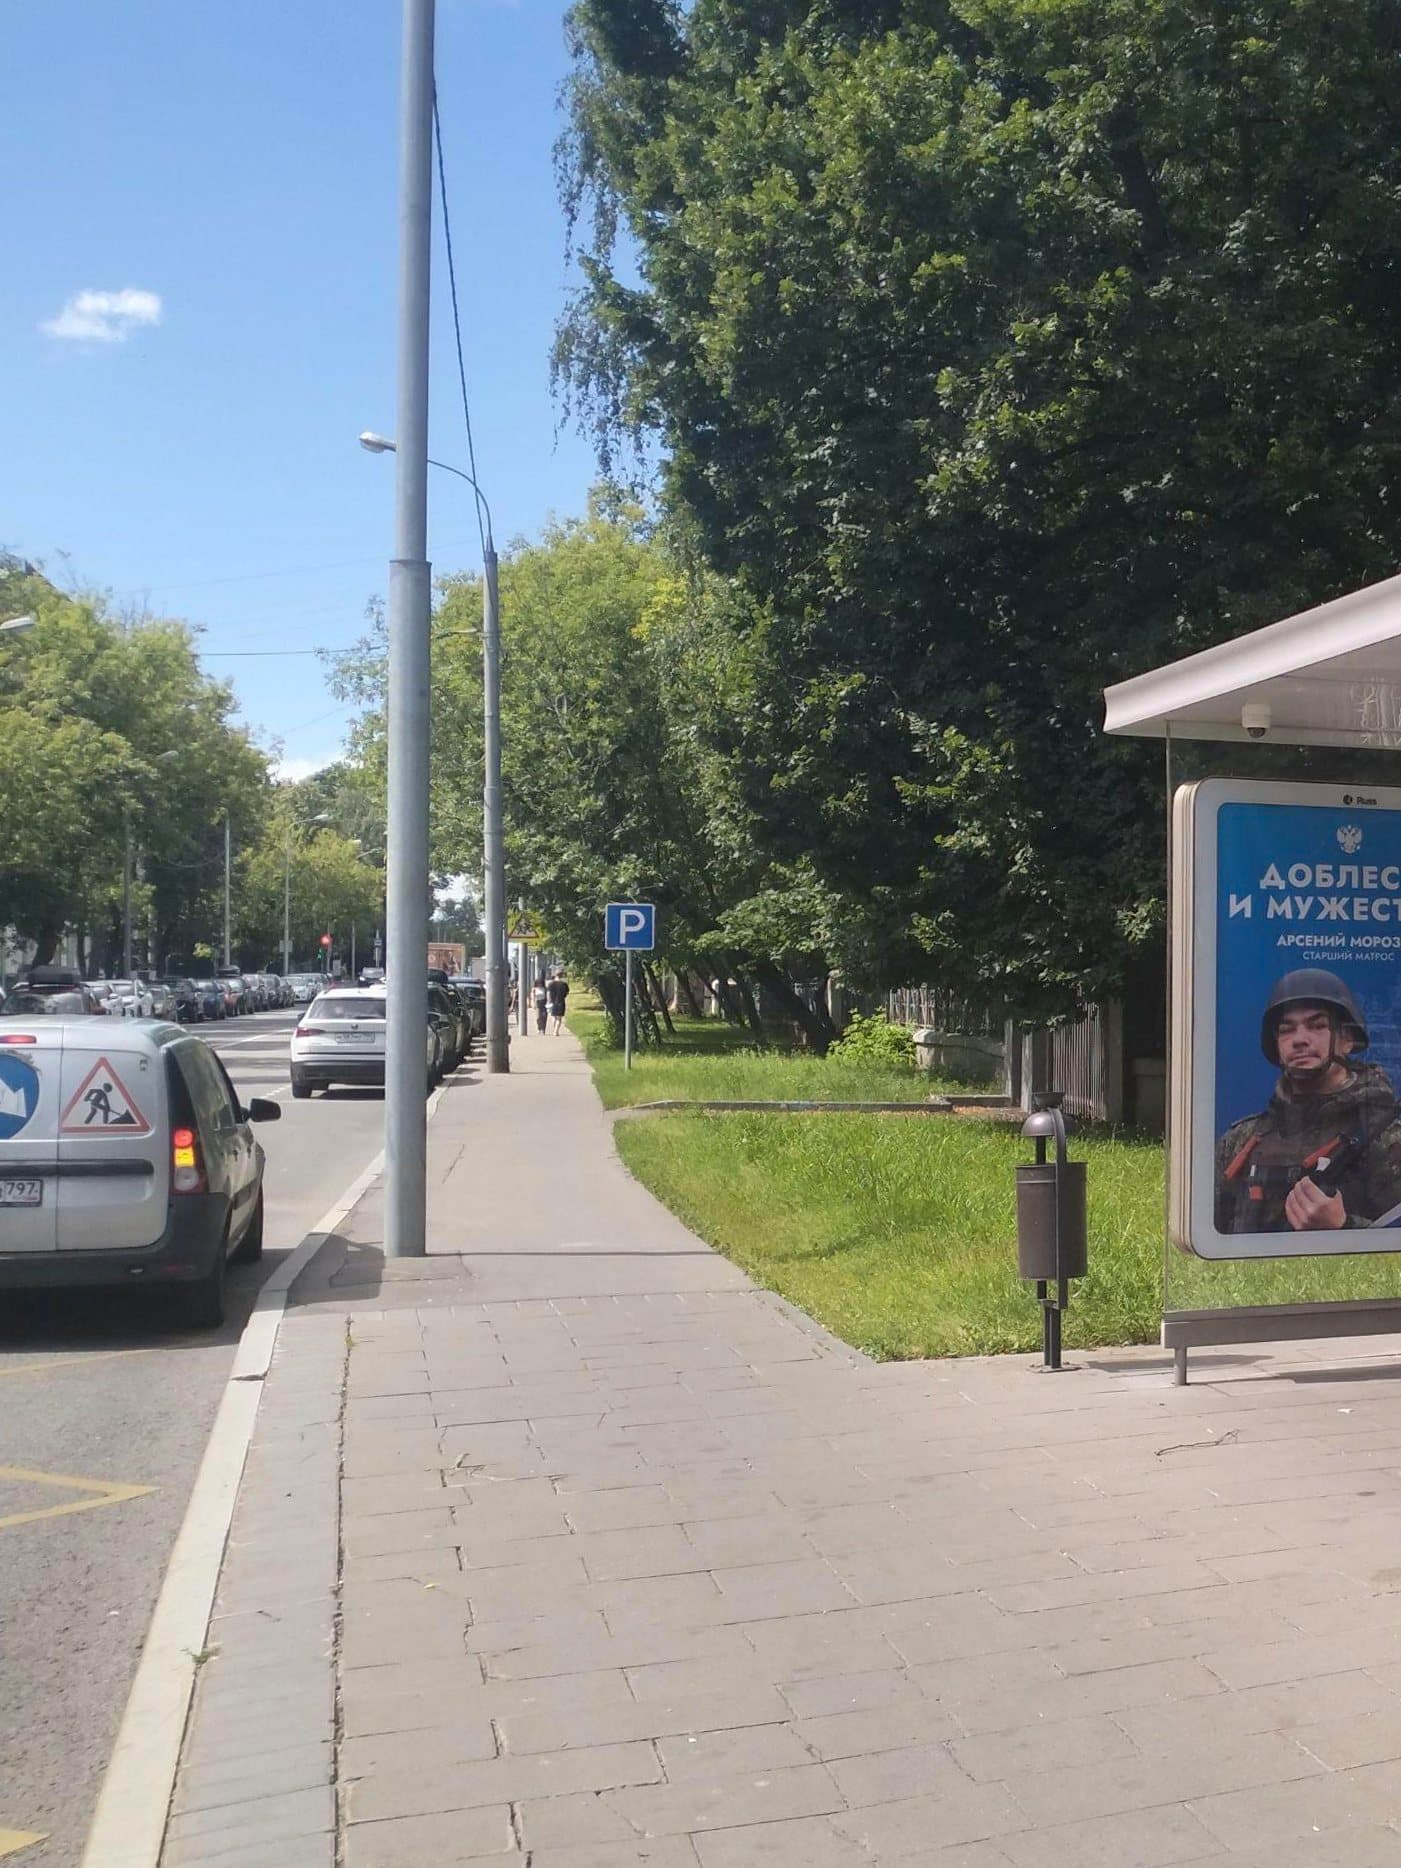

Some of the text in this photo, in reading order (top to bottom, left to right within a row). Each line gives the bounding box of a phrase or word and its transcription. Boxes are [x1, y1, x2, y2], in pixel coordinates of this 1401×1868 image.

[1229, 894, 1252, 918] И
[619, 909, 646, 945] P
[1276, 932, 1346, 948] АРСЕНИЙ
[1302, 949, 1396, 962] СТАРШИЙ МАТРОС
